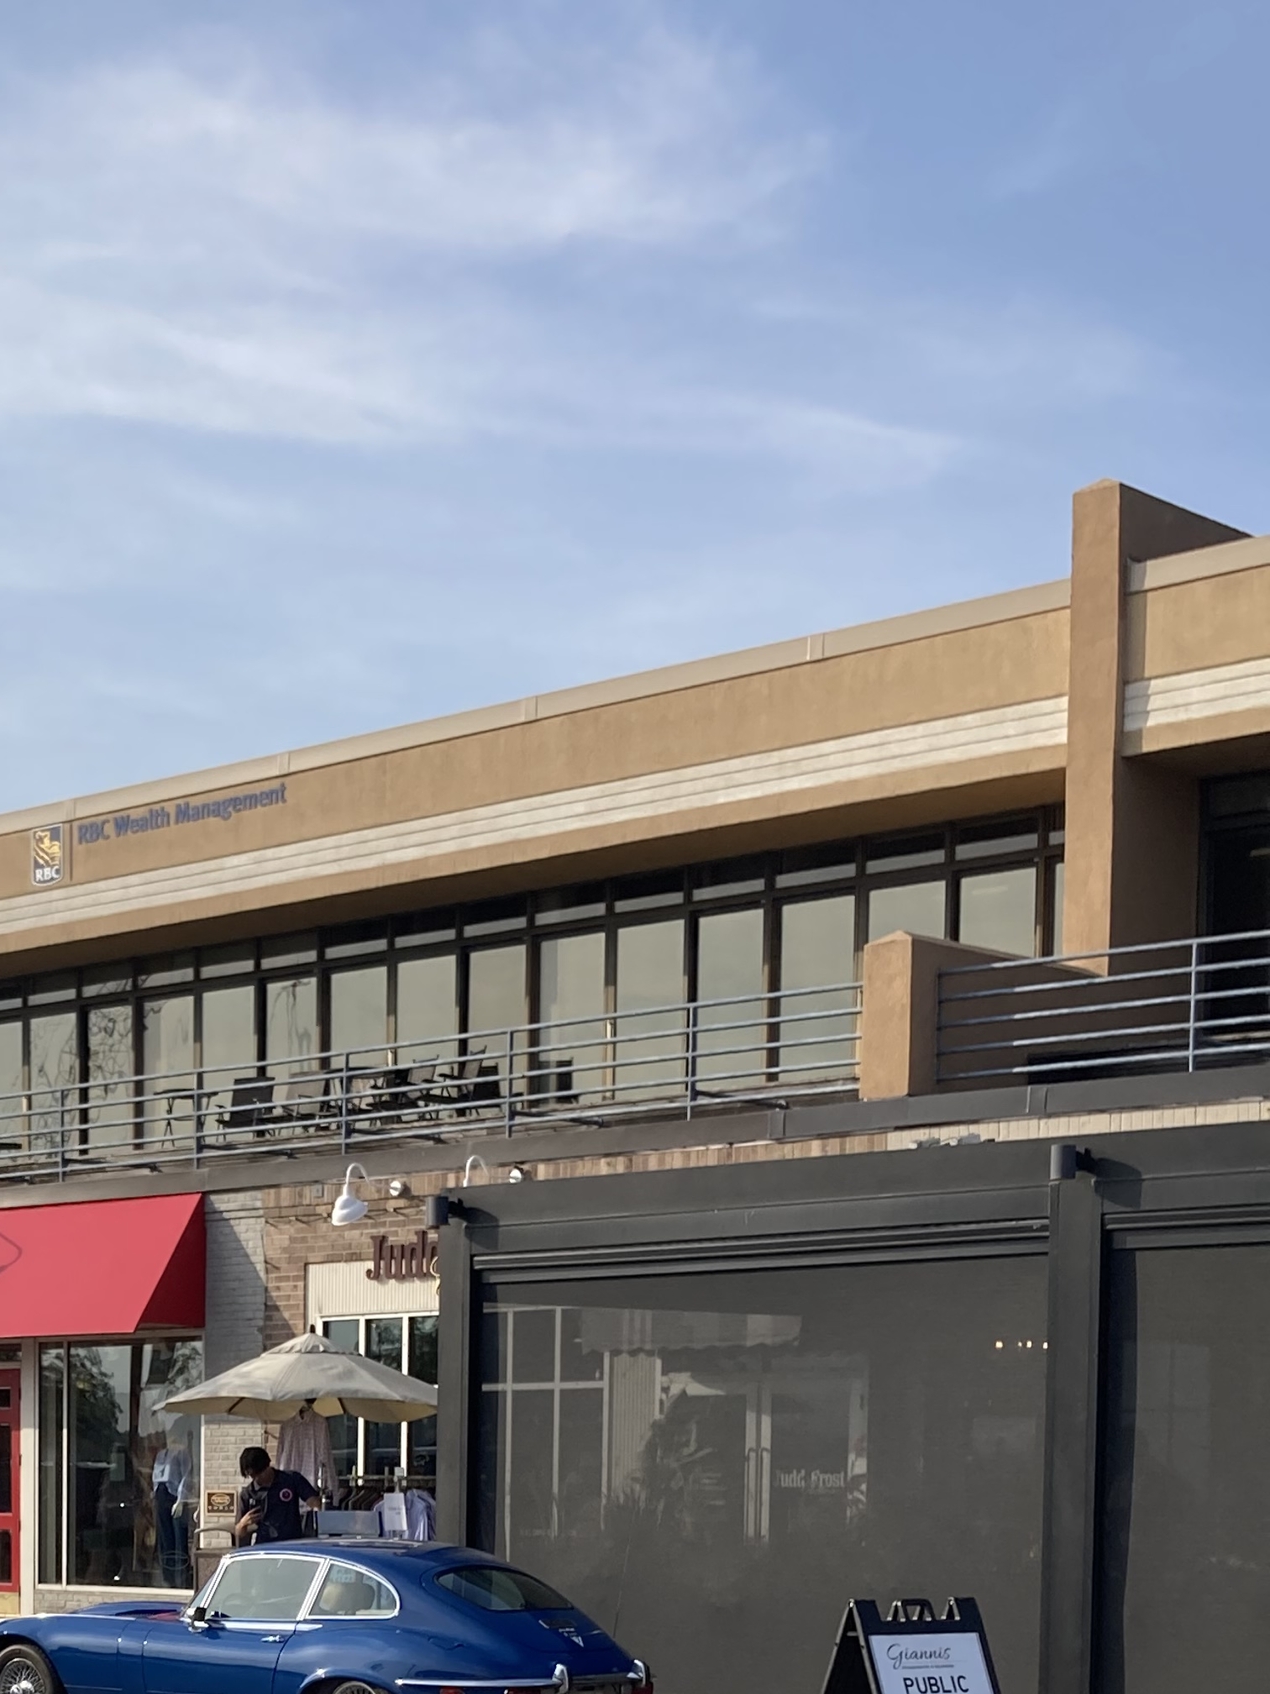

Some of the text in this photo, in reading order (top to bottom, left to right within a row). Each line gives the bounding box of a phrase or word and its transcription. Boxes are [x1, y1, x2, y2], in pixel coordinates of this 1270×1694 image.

[77, 783, 287, 845] RBC Wealth Management
[35, 865, 60, 882] RBC
[887, 1643, 951, 1670] Giannis
[903, 1675, 969, 1694] PUBLIC
